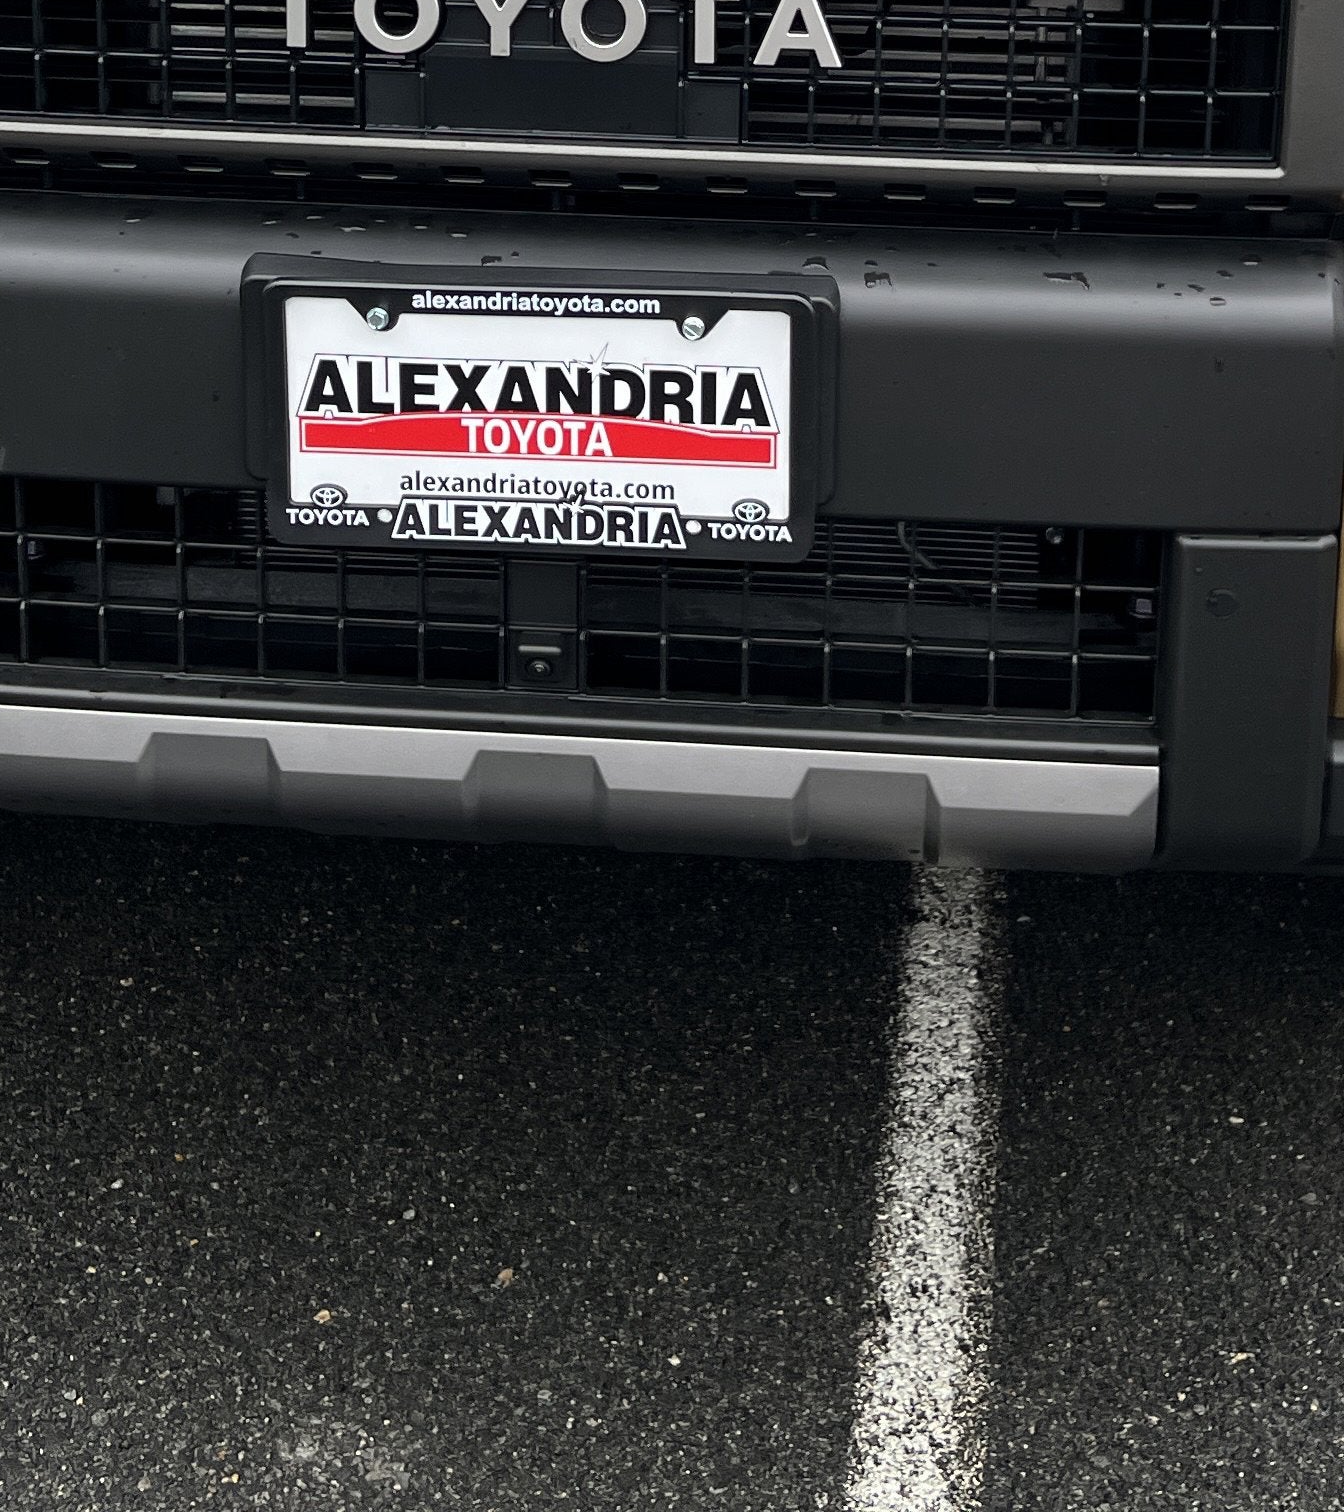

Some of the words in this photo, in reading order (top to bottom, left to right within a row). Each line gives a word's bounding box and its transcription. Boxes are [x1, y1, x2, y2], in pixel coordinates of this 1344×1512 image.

[411, 289, 661, 316] alexandriatoyota.com
[303, 357, 777, 430] ALEXANDRIA
[460, 417, 613, 458] TOYOTA
[399, 470, 675, 500] alexandriatoyota.com
[285, 506, 370, 528] TOYOTA
[391, 500, 686, 548] ALEXANDRIA
[707, 522, 793, 544] TOYOTA
